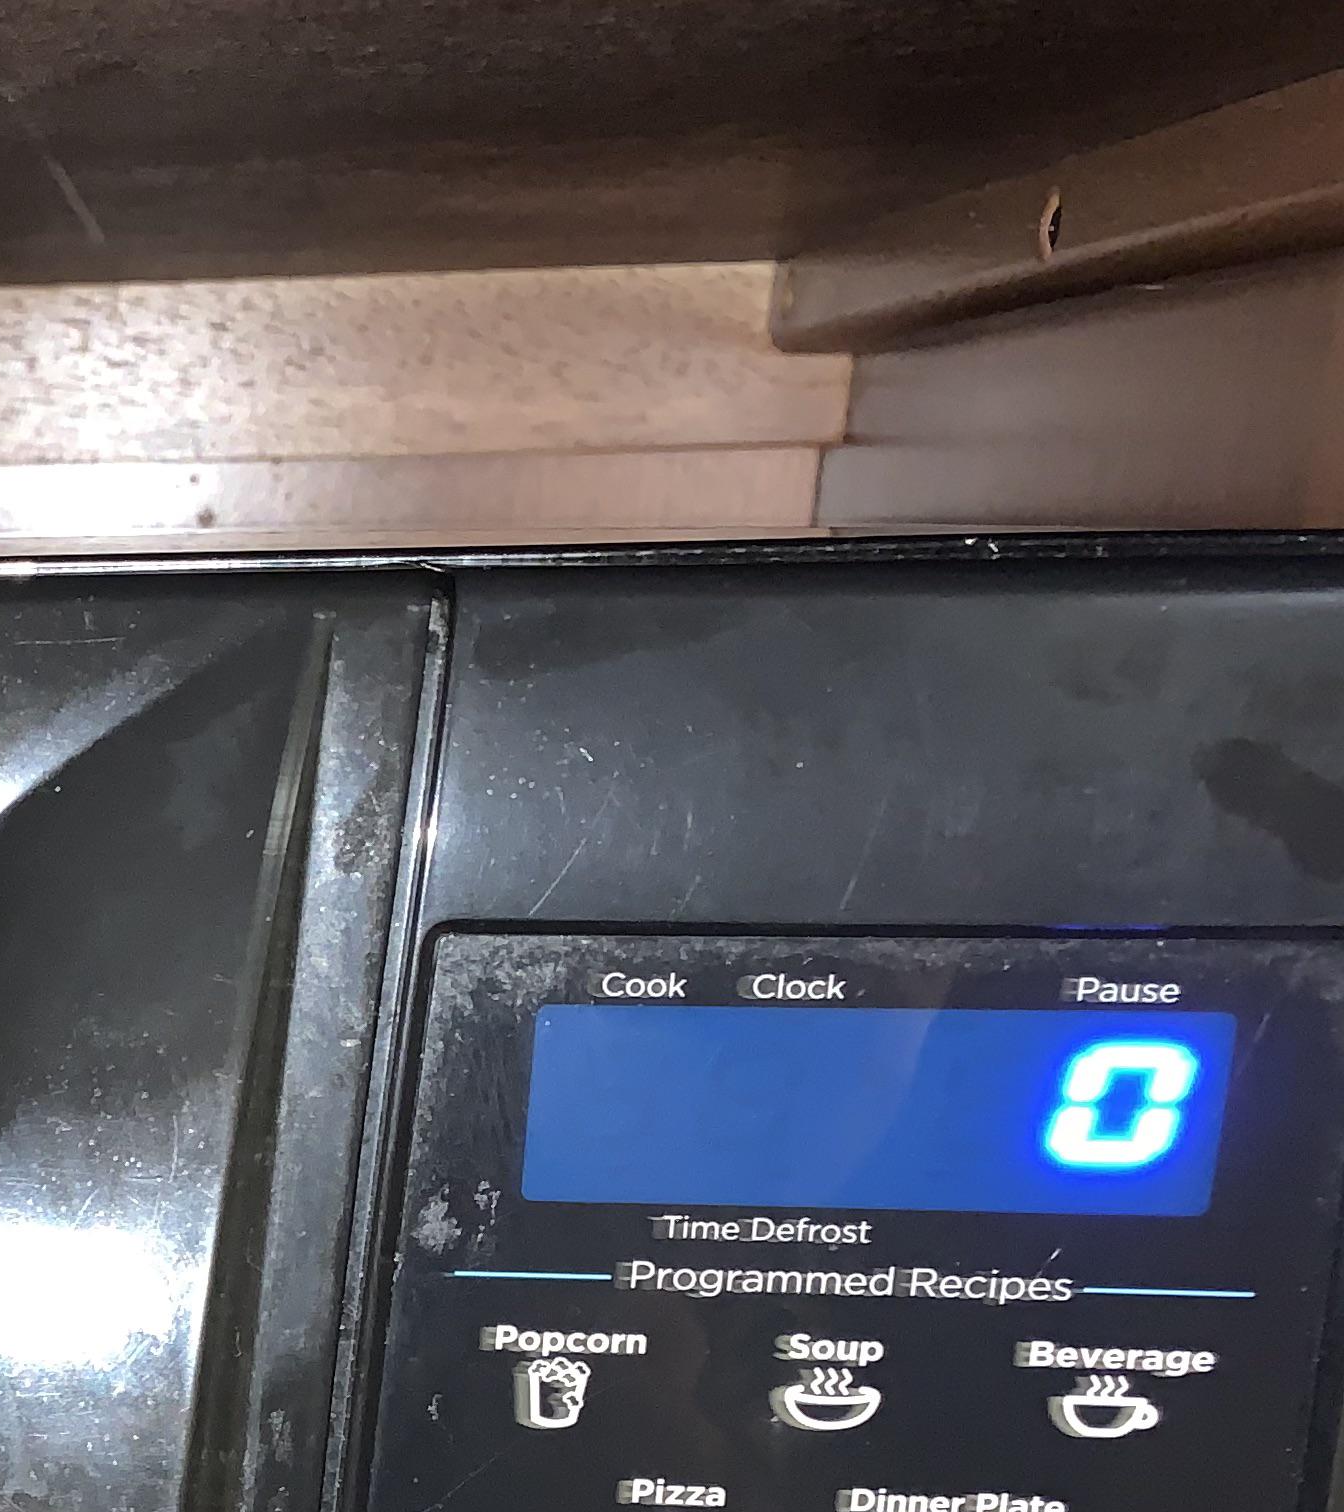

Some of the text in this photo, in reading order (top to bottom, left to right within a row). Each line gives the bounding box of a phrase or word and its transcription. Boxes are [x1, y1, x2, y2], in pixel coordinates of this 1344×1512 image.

[601, 971, 688, 999] Cook
[751, 972, 847, 1001] Clock
[1076, 976, 1181, 1004] Pause
[1044, 1038, 1202, 1169] 0
[659, 1214, 873, 1245] Time Defrost
[629, 1259, 1074, 1306] Programmed Recipes
[493, 1323, 649, 1360] Popcorn
[786, 1332, 886, 1367] Soup
[1025, 1339, 1217, 1377] Beverage
[630, 1477, 727, 1508] Pizza
